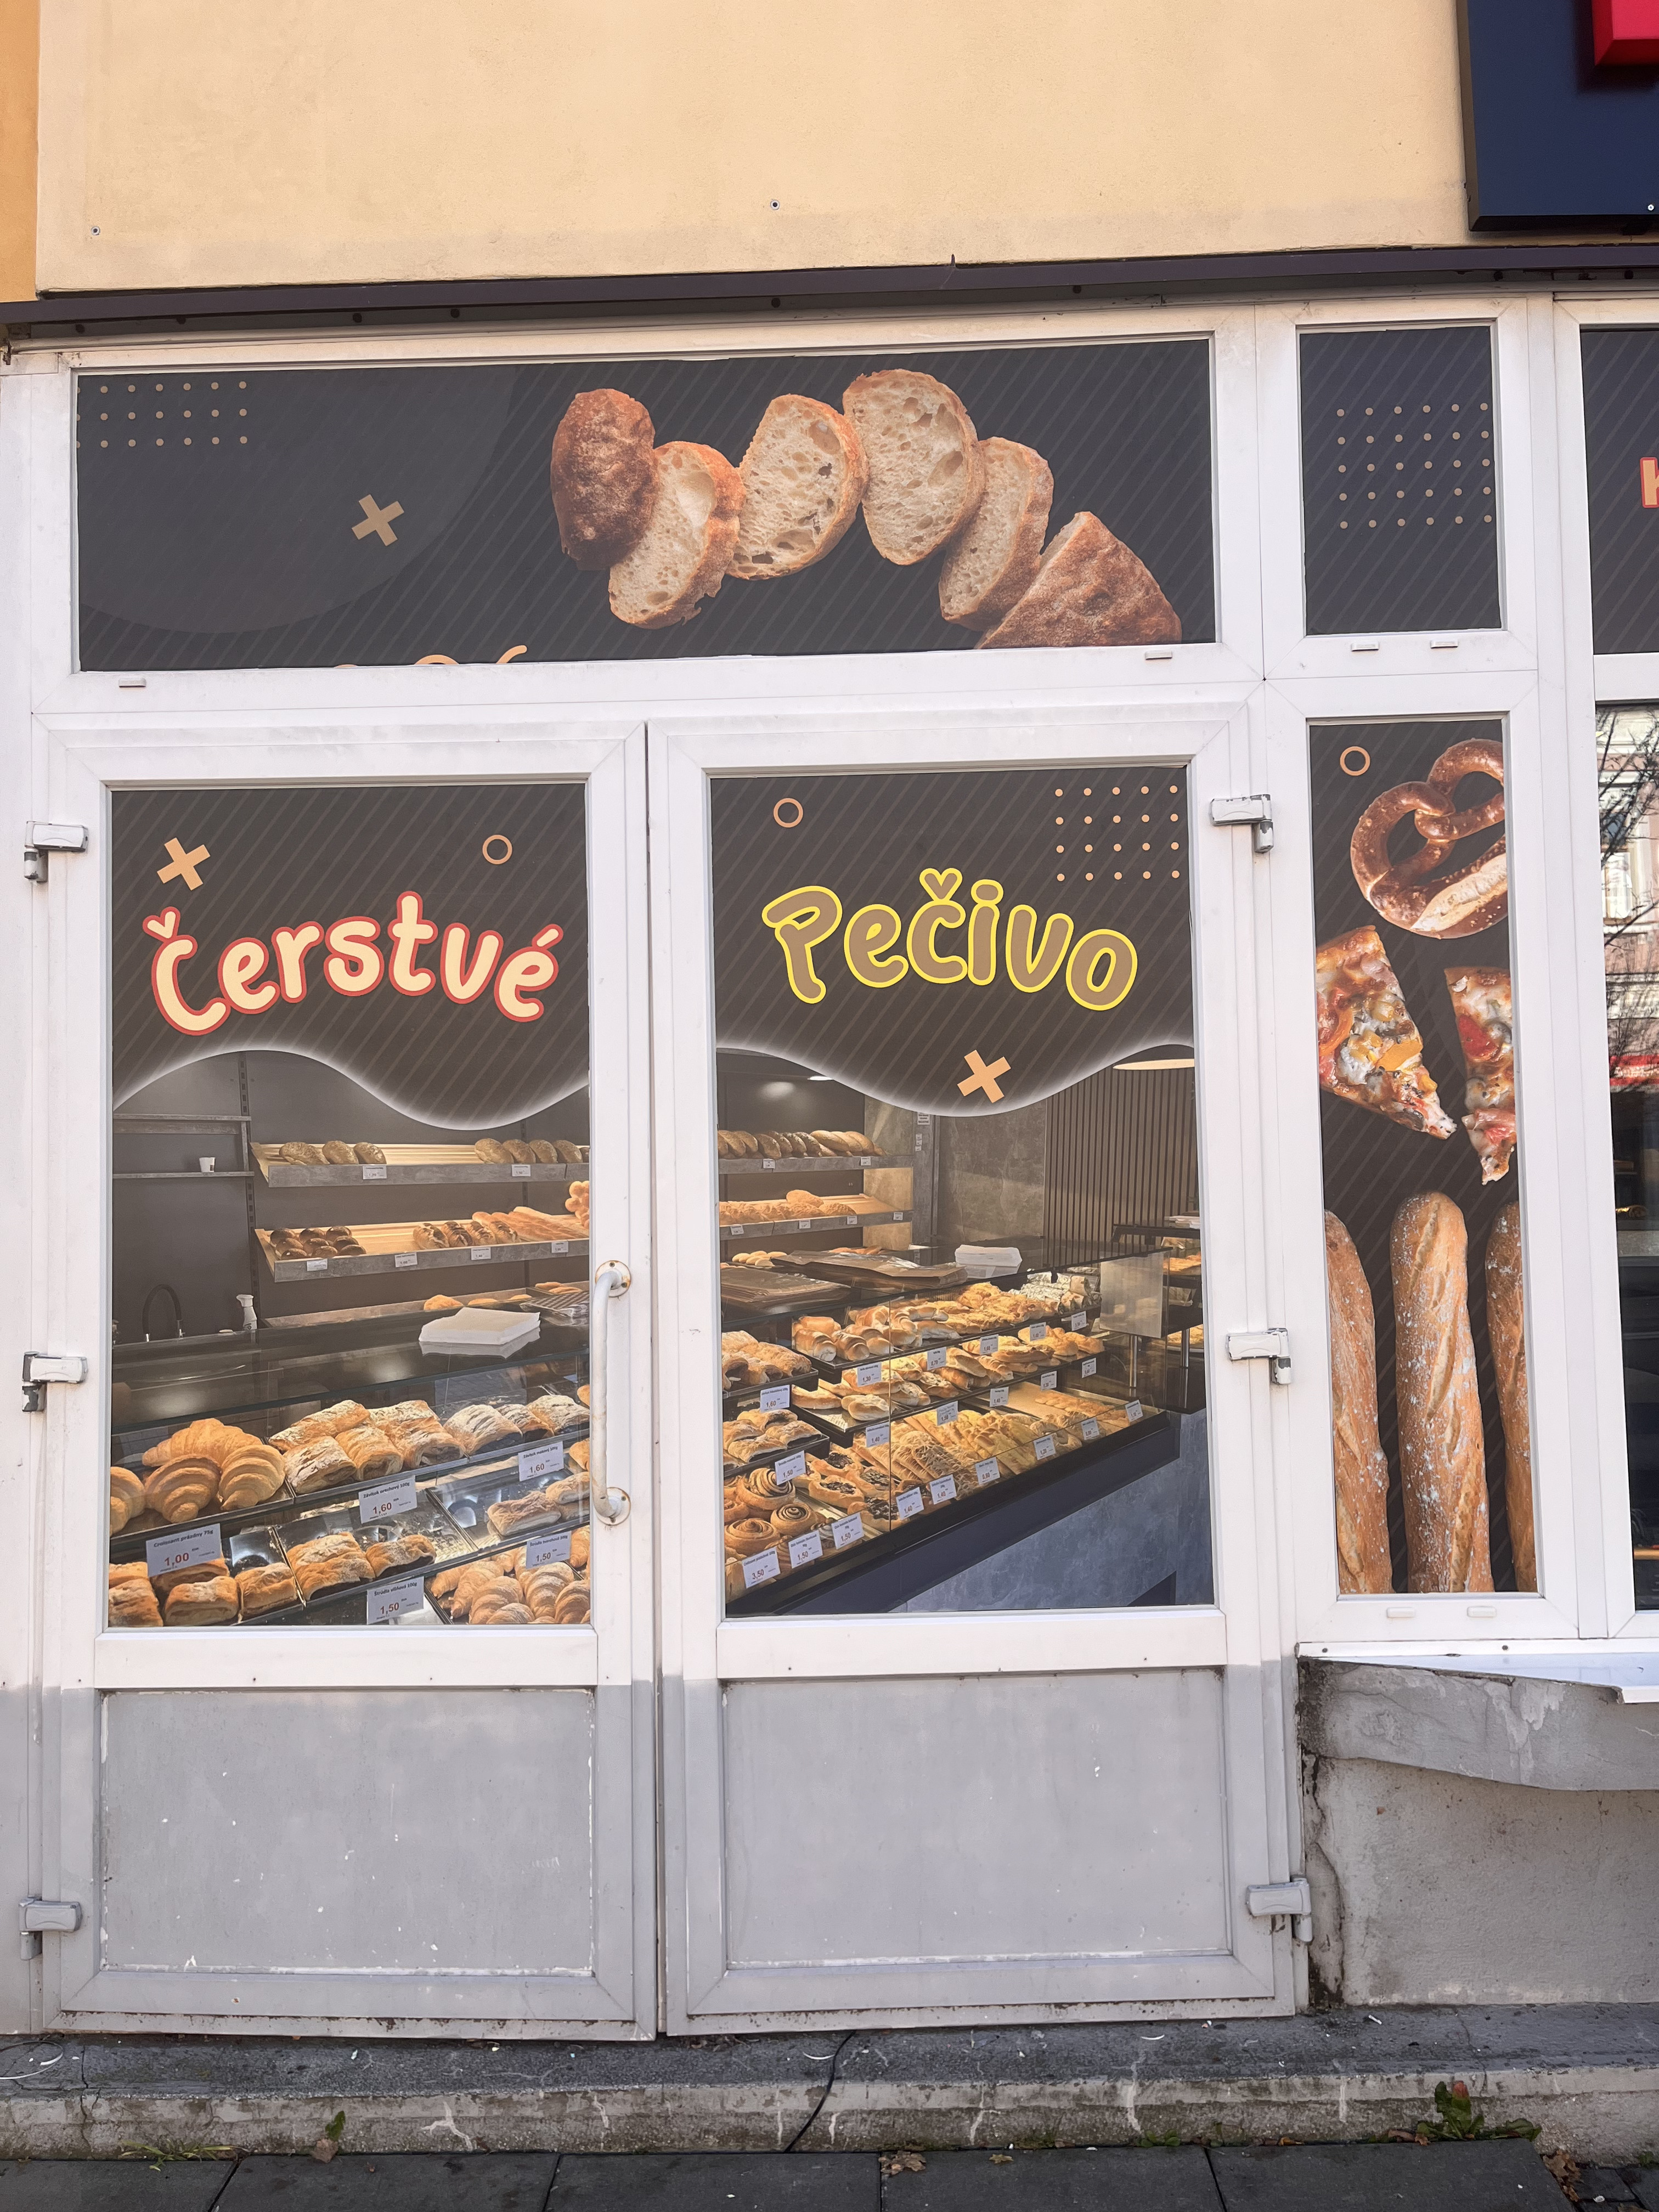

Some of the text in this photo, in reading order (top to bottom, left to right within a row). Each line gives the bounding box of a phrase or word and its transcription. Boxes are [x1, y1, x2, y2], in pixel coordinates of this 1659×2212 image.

[762, 867, 1138, 1011] Pečivo
[143, 891, 563, 1035] Čerstvé
[529, 1463, 544, 1473] 1,60
[363, 1490, 379, 1498] Závitok
[373, 1502, 392, 1514] 1,60
[154, 1538, 180, 1547] Croissant
[180, 1532, 203, 1542] prázdny
[165, 1553, 189, 1568] 1,00
[536, 1551, 551, 1562] 1,50
[798, 1550, 809, 1560] 1,50
[752, 1569, 764, 1580] 3,50
[380, 1602, 399, 1614] 1,50
